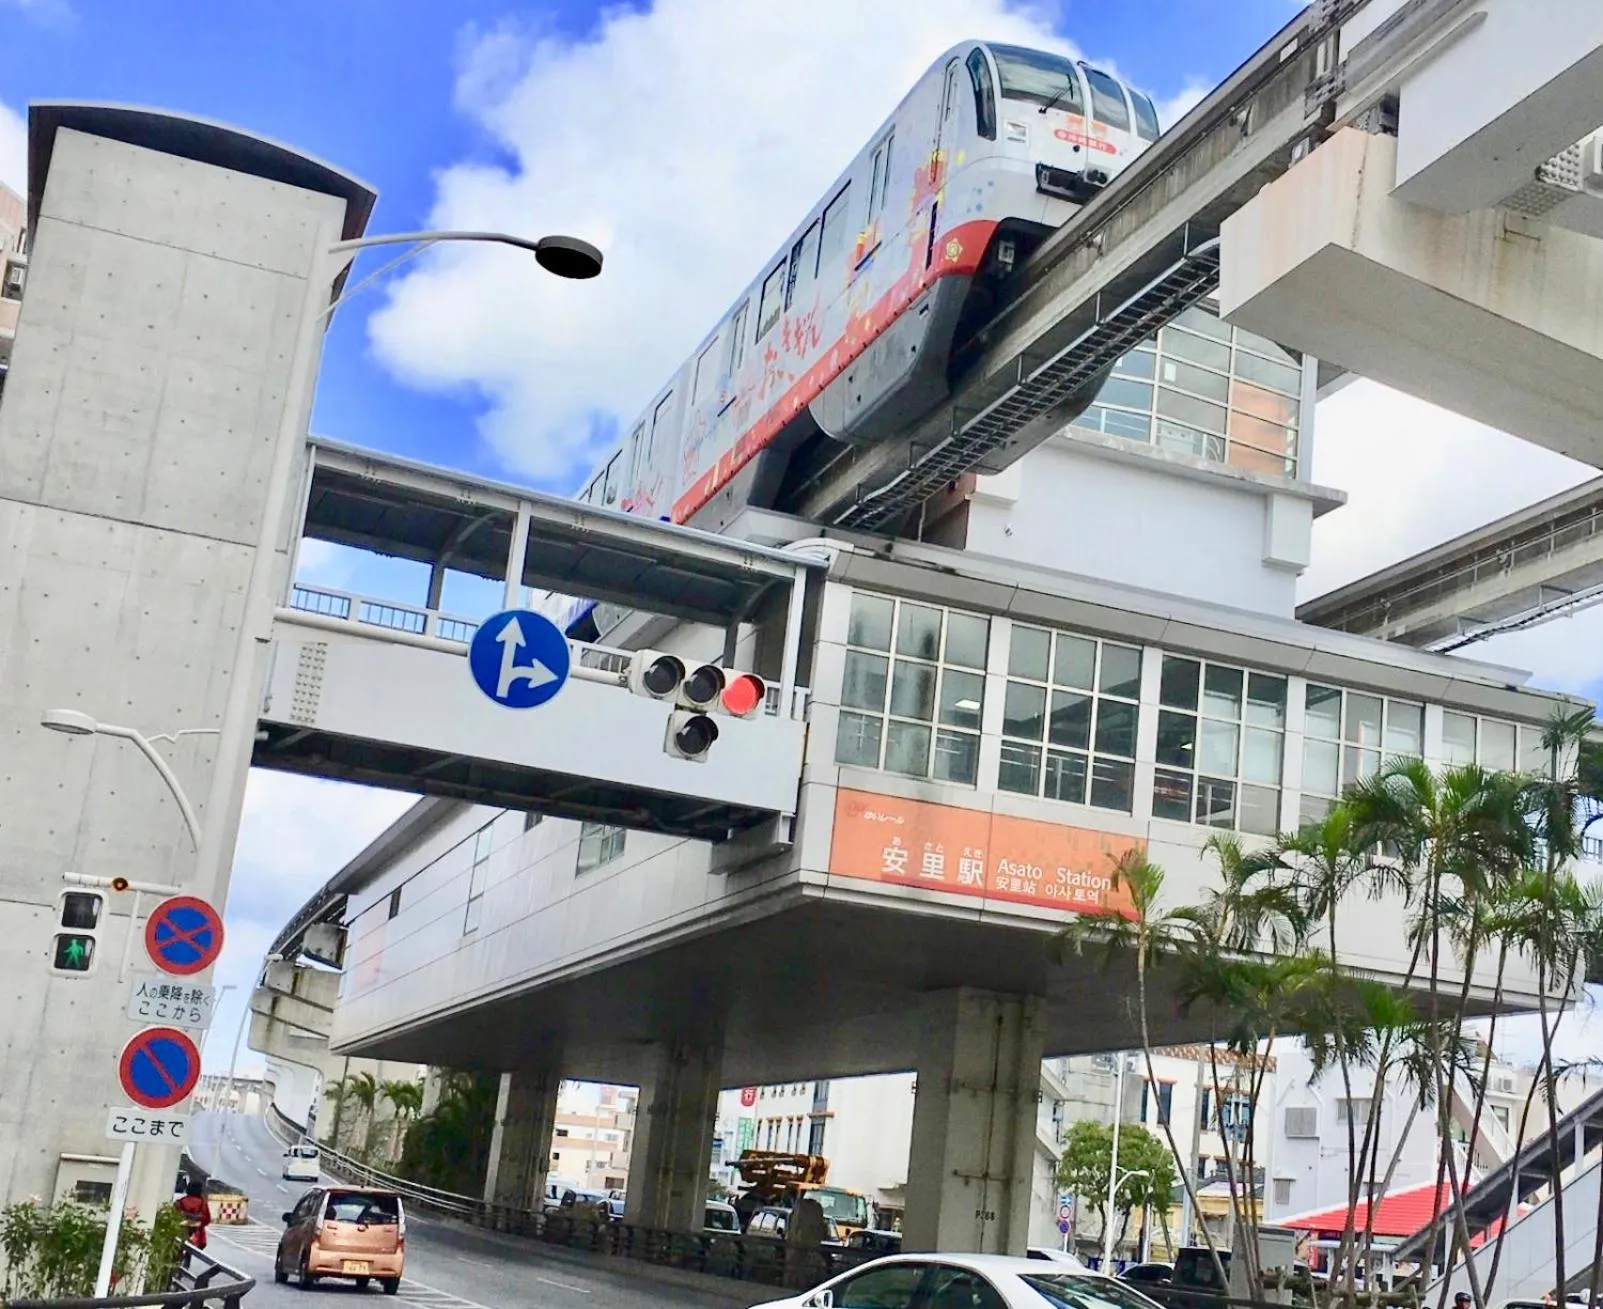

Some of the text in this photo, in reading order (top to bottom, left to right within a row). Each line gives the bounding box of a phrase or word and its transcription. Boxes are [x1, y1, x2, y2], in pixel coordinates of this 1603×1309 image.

[882, 847, 984, 888] 安里駅
[997, 858, 1112, 891] Asato Station
[995, 876, 1036, 896] 安里站
[139, 1001, 201, 1022] ここから
[113, 1116, 184, 1137] ここまで
